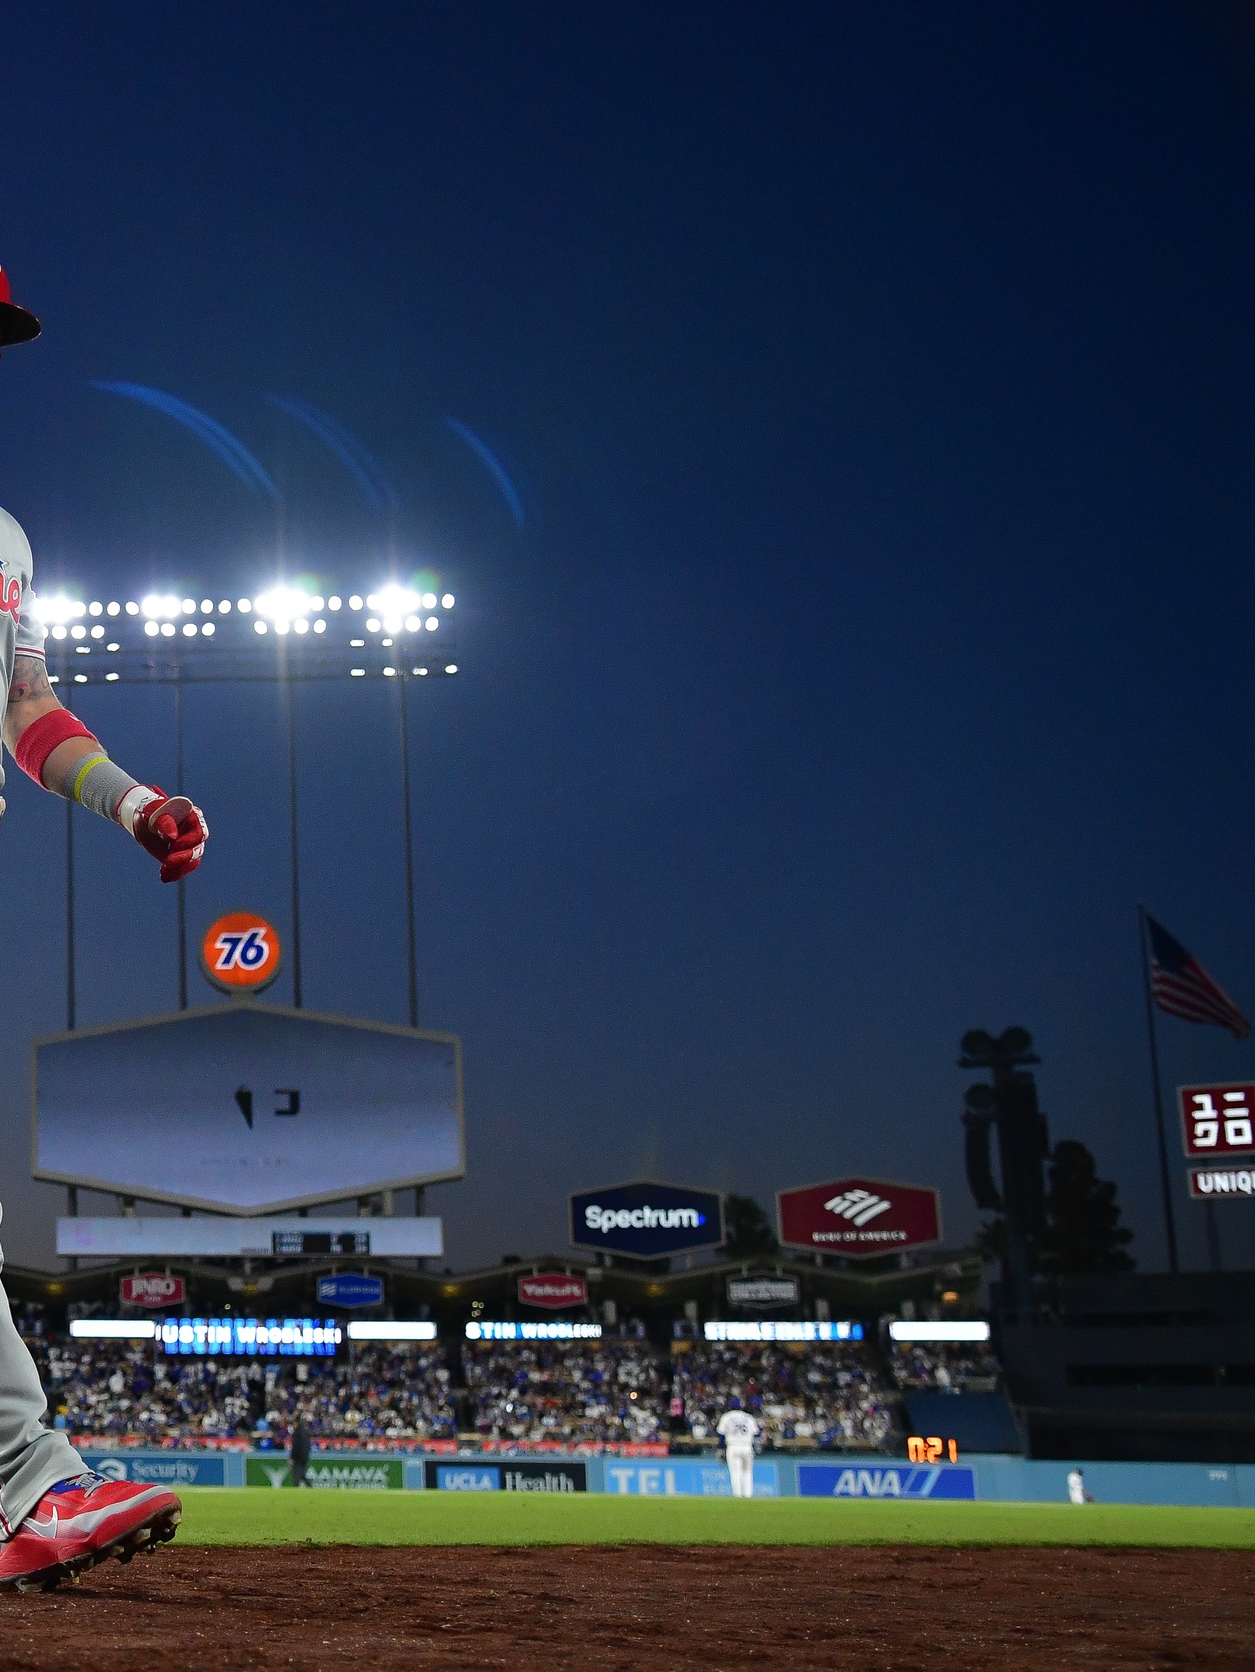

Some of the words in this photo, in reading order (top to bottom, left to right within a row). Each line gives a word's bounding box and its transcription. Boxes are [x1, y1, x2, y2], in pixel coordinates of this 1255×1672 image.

[214, 927, 270, 971] 76
[1196, 1170, 1255, 1195] UNIQ
[585, 1204, 699, 1234] Spectrum
[842, 1231, 857, 1242] OF
[858, 1230, 907, 1242] AMERICA
[236, 1325, 341, 1344] WROBLESKI
[132, 1459, 200, 1482] Security
[304, 1463, 390, 1480] AAMAVA'
[445, 1472, 493, 1490] UCLA
[505, 1471, 575, 1492] Health
[834, 1469, 902, 1496] ANA
